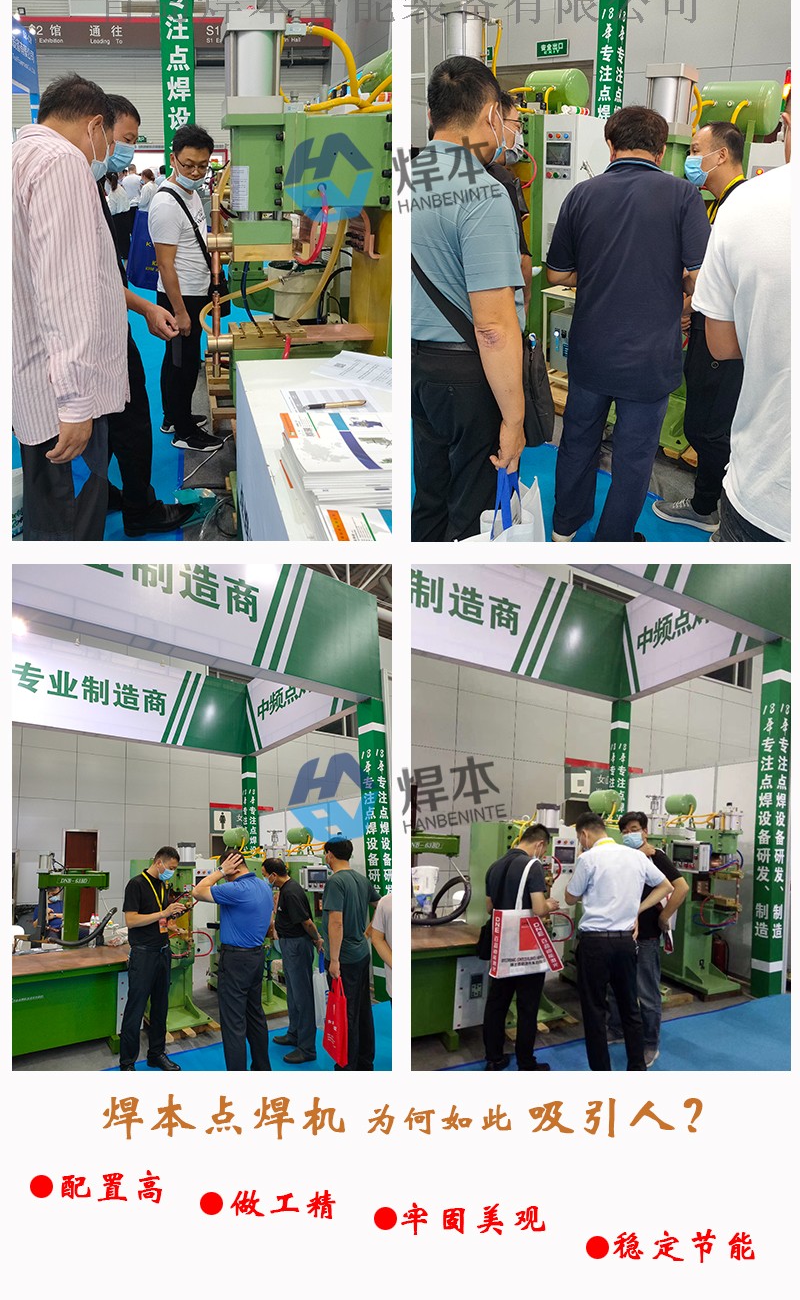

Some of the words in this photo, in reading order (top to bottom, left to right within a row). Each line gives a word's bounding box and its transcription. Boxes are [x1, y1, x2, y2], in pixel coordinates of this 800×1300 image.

[50, 24, 62, 37] 馆
[89, 25, 123, 37] 通往
[206, 25, 220, 36] S1
[540, 42, 564, 52] 安全出口
[411, 568, 521, 636] 制造商
[636, 609, 709, 655] 中频点
[12, 661, 168, 717] 专业制造商
[257, 685, 311, 720] 中频点
